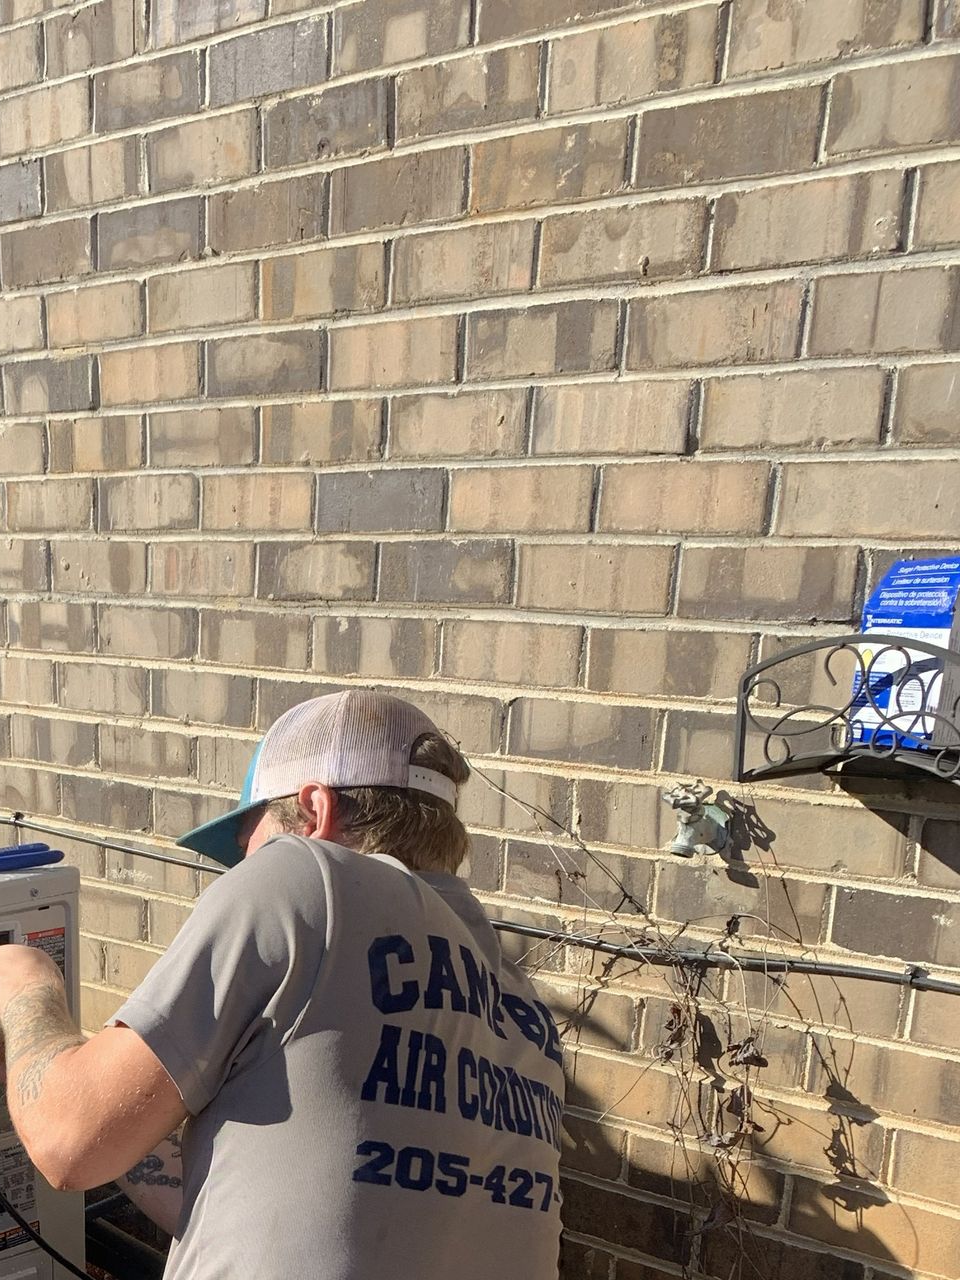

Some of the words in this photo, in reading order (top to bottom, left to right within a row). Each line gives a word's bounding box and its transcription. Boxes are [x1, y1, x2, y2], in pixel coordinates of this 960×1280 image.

[921, 576, 950, 584] surtension
[879, 591, 908, 599] Dispositivo
[360, 1024, 447, 1114] AIR
